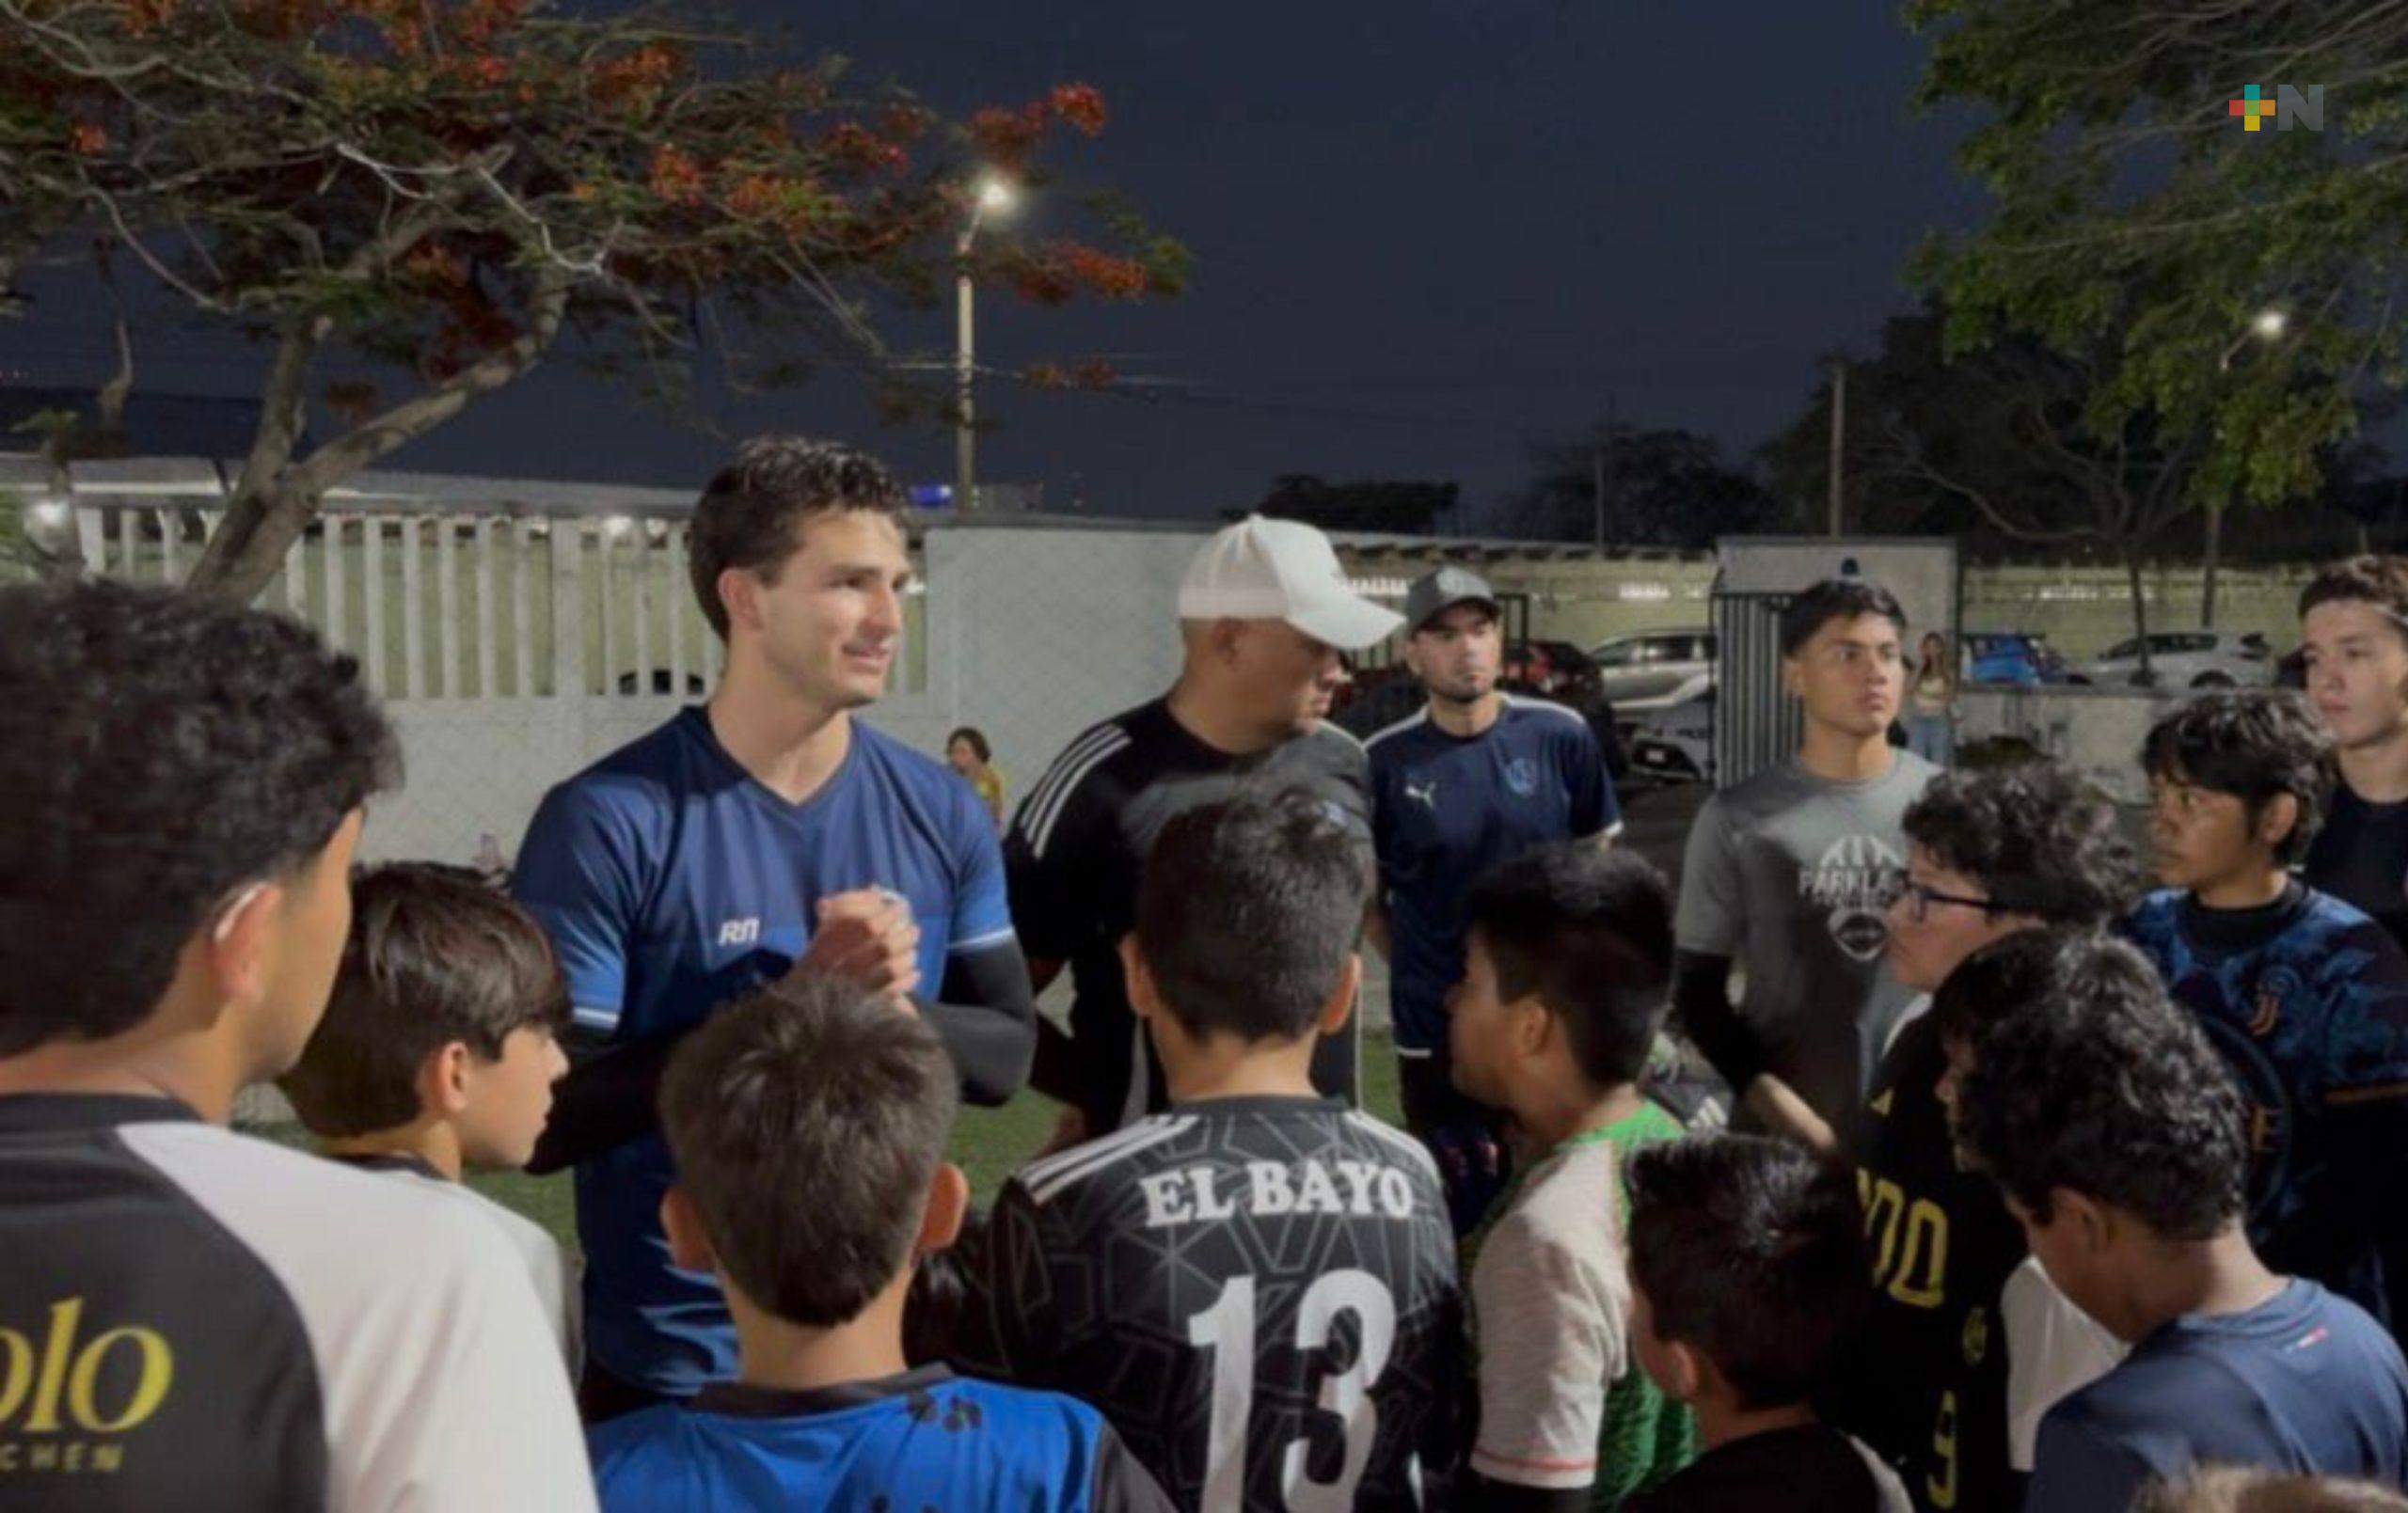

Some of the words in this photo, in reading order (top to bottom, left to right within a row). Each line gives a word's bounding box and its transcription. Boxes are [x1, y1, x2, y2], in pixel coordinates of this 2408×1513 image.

[1139, 1168, 1235, 1227] EL
[1246, 1159, 1413, 1218] BAYO
[1189, 1268, 1396, 1513] 13
